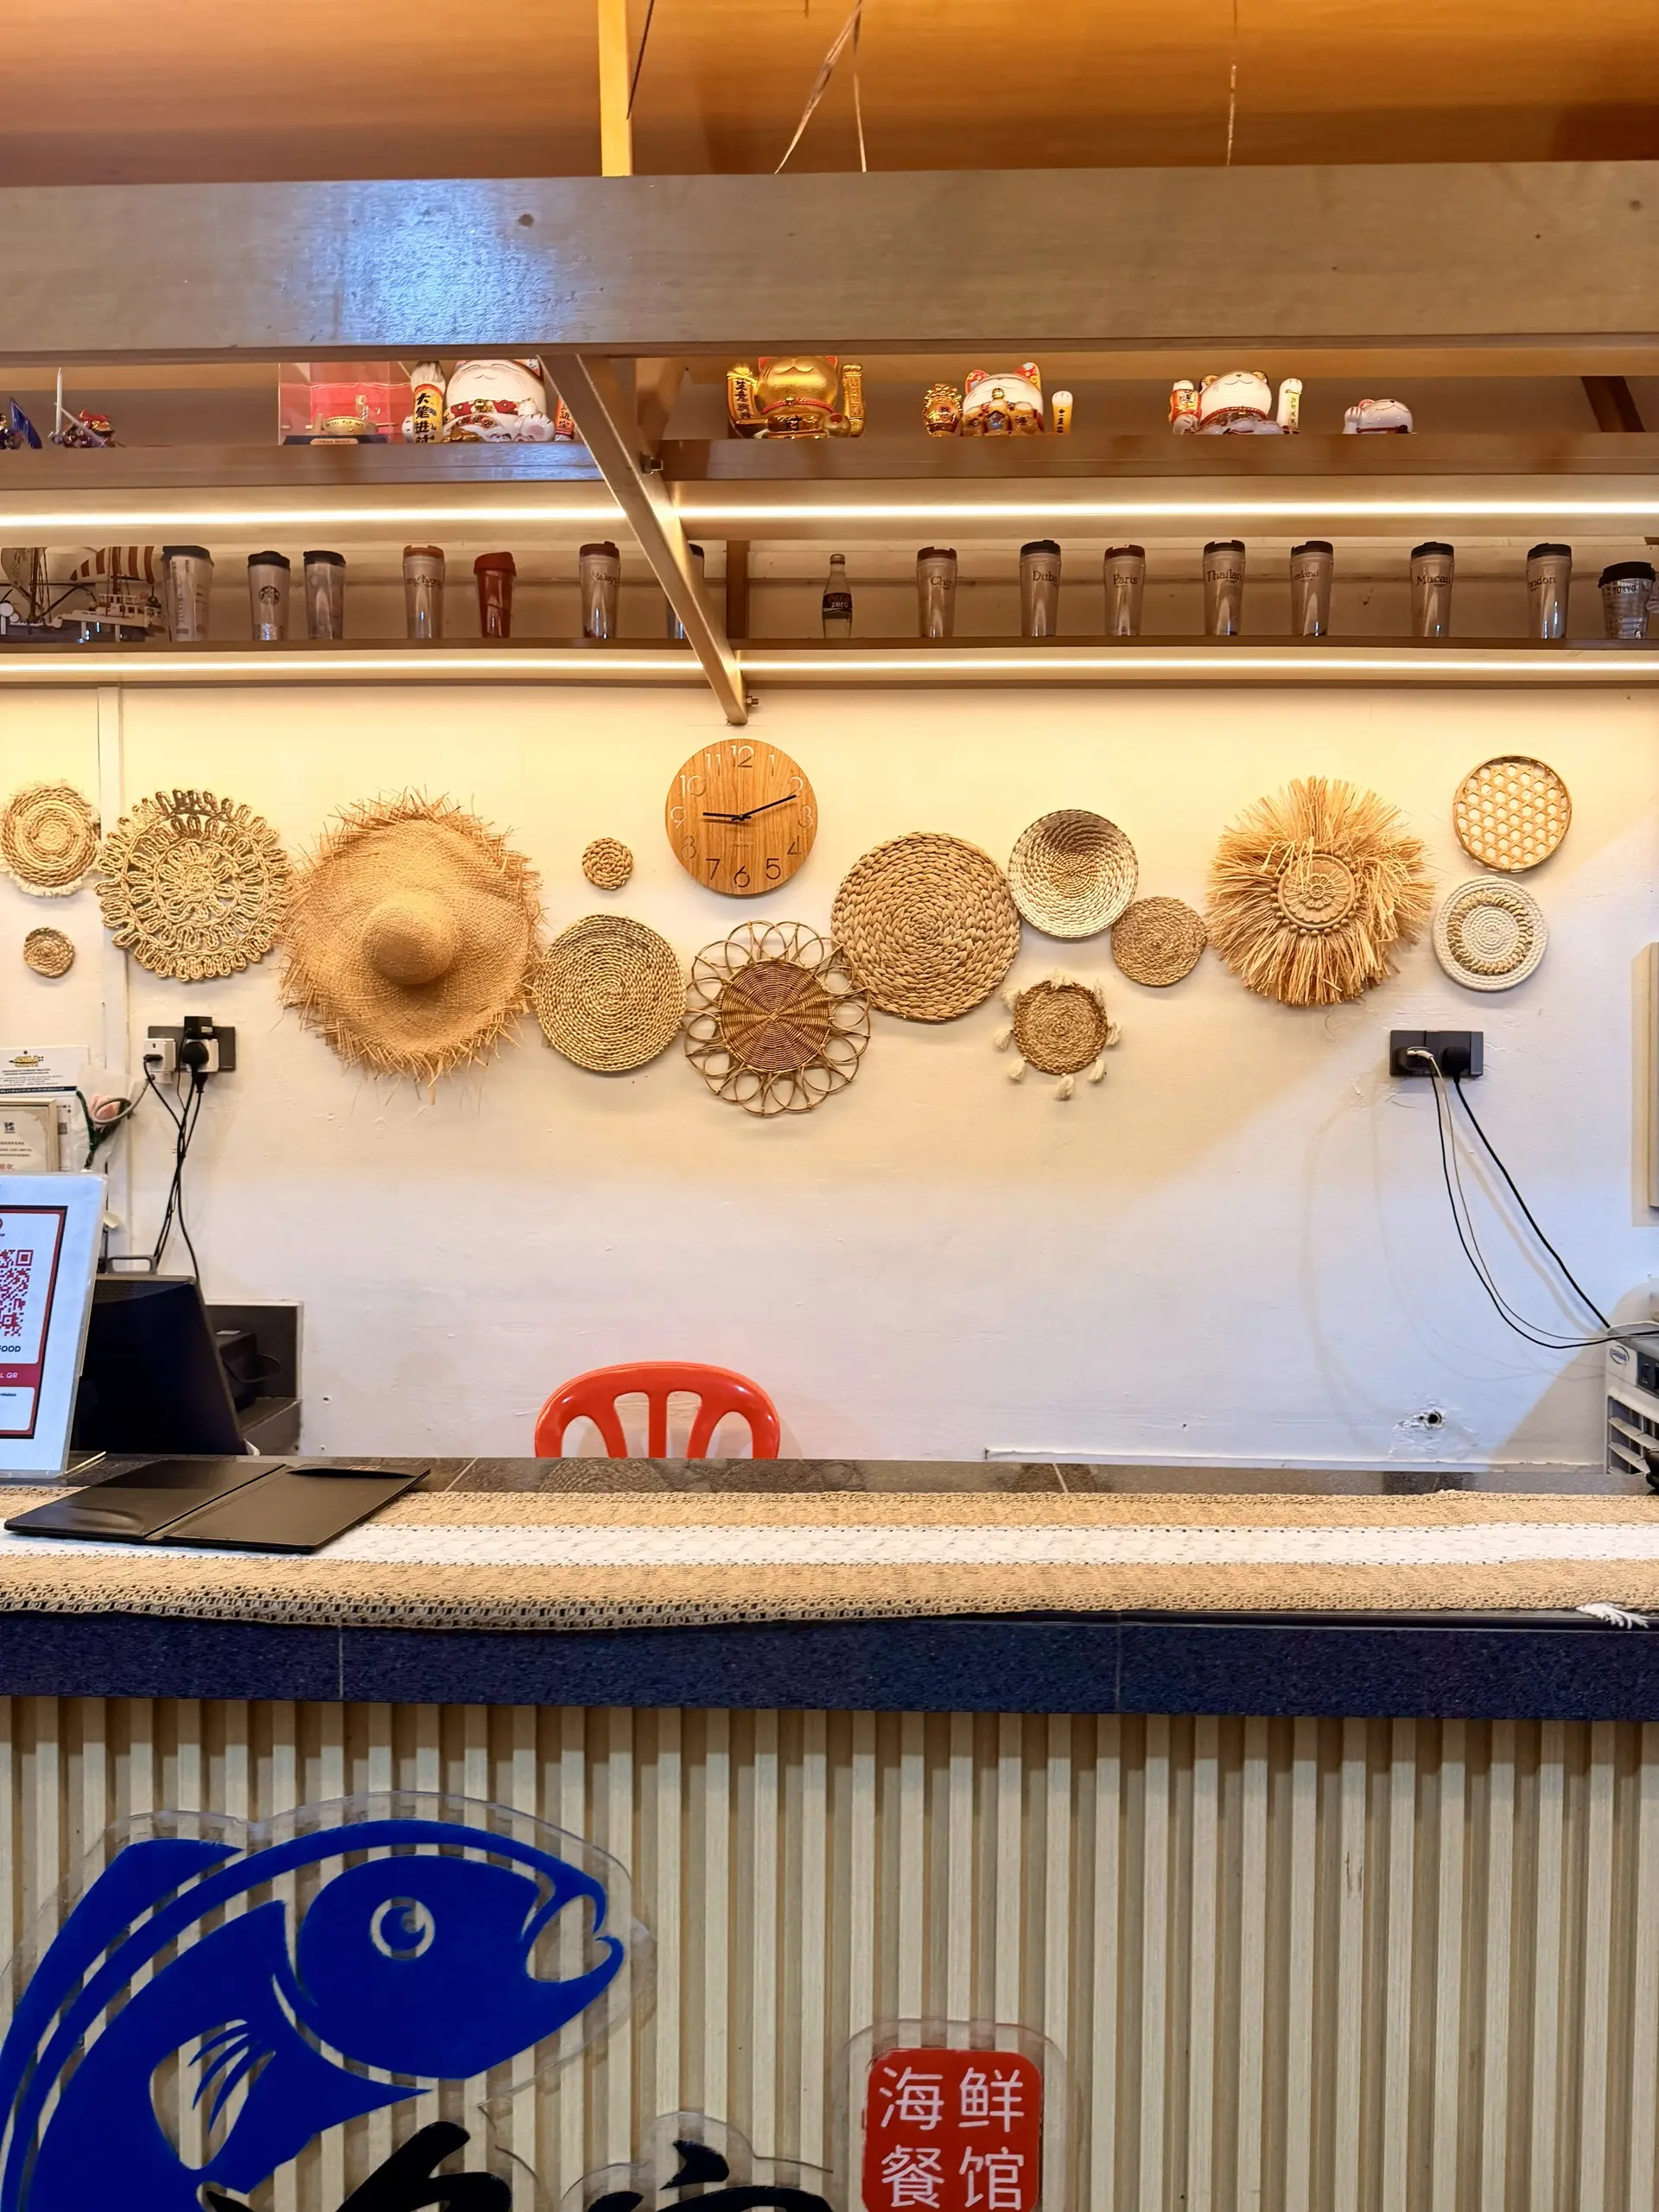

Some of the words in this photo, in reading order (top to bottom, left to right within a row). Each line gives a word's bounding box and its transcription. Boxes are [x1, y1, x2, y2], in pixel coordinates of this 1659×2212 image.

[1113, 574, 1138, 585] Paris
[1416, 575, 1451, 587] Macau
[705, 753, 721, 777] 11
[731, 745, 754, 768] 12
[769, 754, 776, 777] 1
[680, 774, 706, 798] 10
[670, 805, 686, 830] 9
[798, 805, 813, 829] 3
[682, 835, 696, 859] 8
[787, 835, 802, 857] 4
[705, 858, 721, 880] 7
[734, 866, 751, 887] 6
[766, 858, 781, 880] 5
[879, 2066, 1025, 2133] 海鲜
[880, 2144, 1025, 2210] 餐馆
